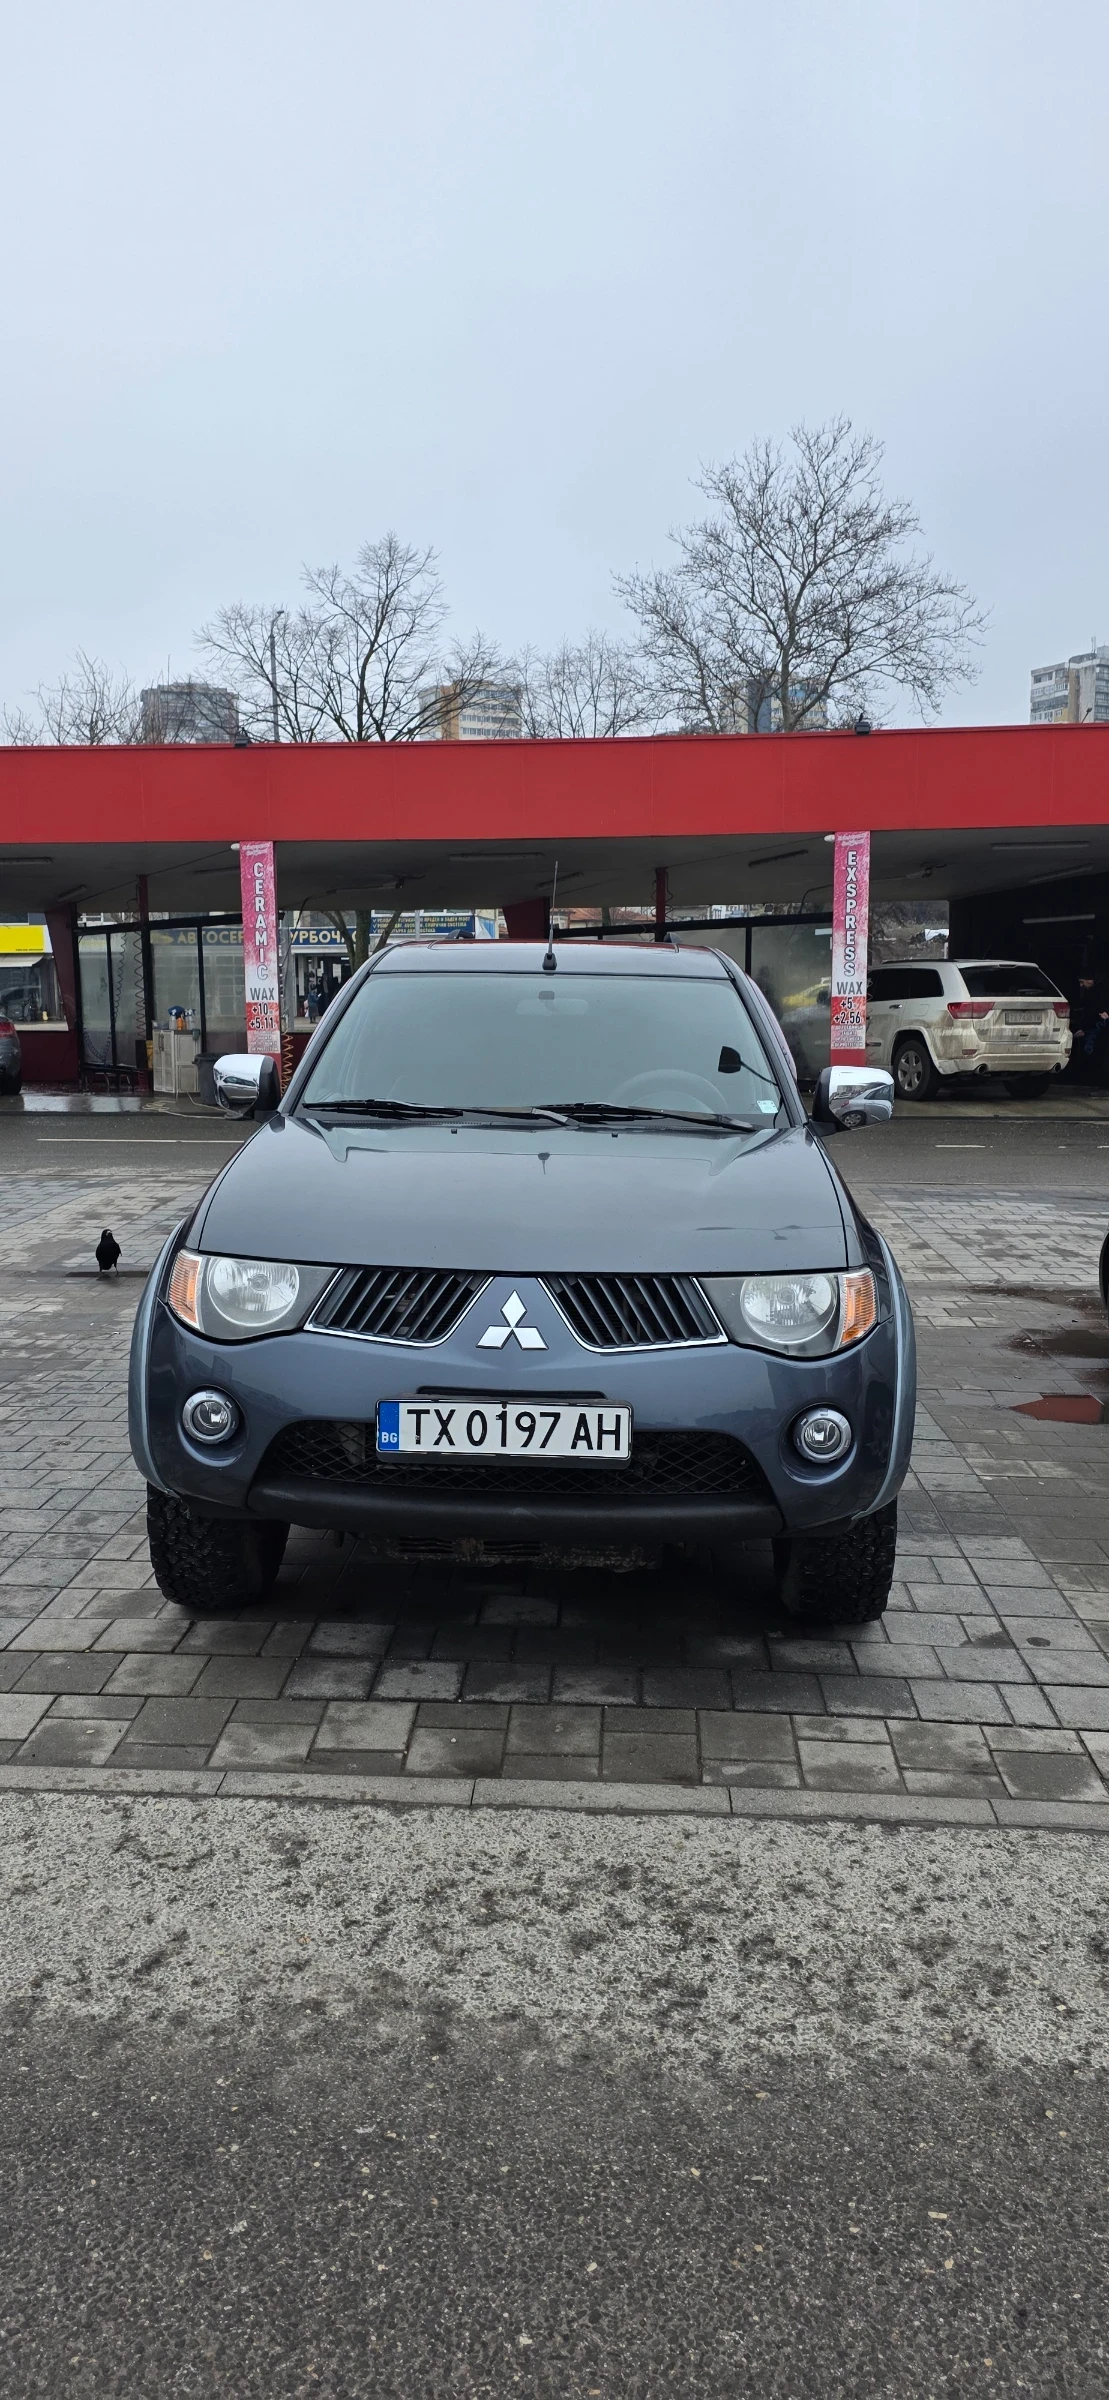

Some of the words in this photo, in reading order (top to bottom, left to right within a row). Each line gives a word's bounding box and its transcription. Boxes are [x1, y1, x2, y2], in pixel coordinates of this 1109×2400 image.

[253, 862, 269, 981] CERAMIC
[844, 851, 857, 977] EXSPRESS
[250, 987, 275, 1001] WAX
[836, 982, 863, 995] WAX
[381, 1431, 398, 1444] BG
[407, 1409, 456, 1446] TX
[466, 1409, 561, 1448] 0197
[570, 1413, 621, 1451] AH
